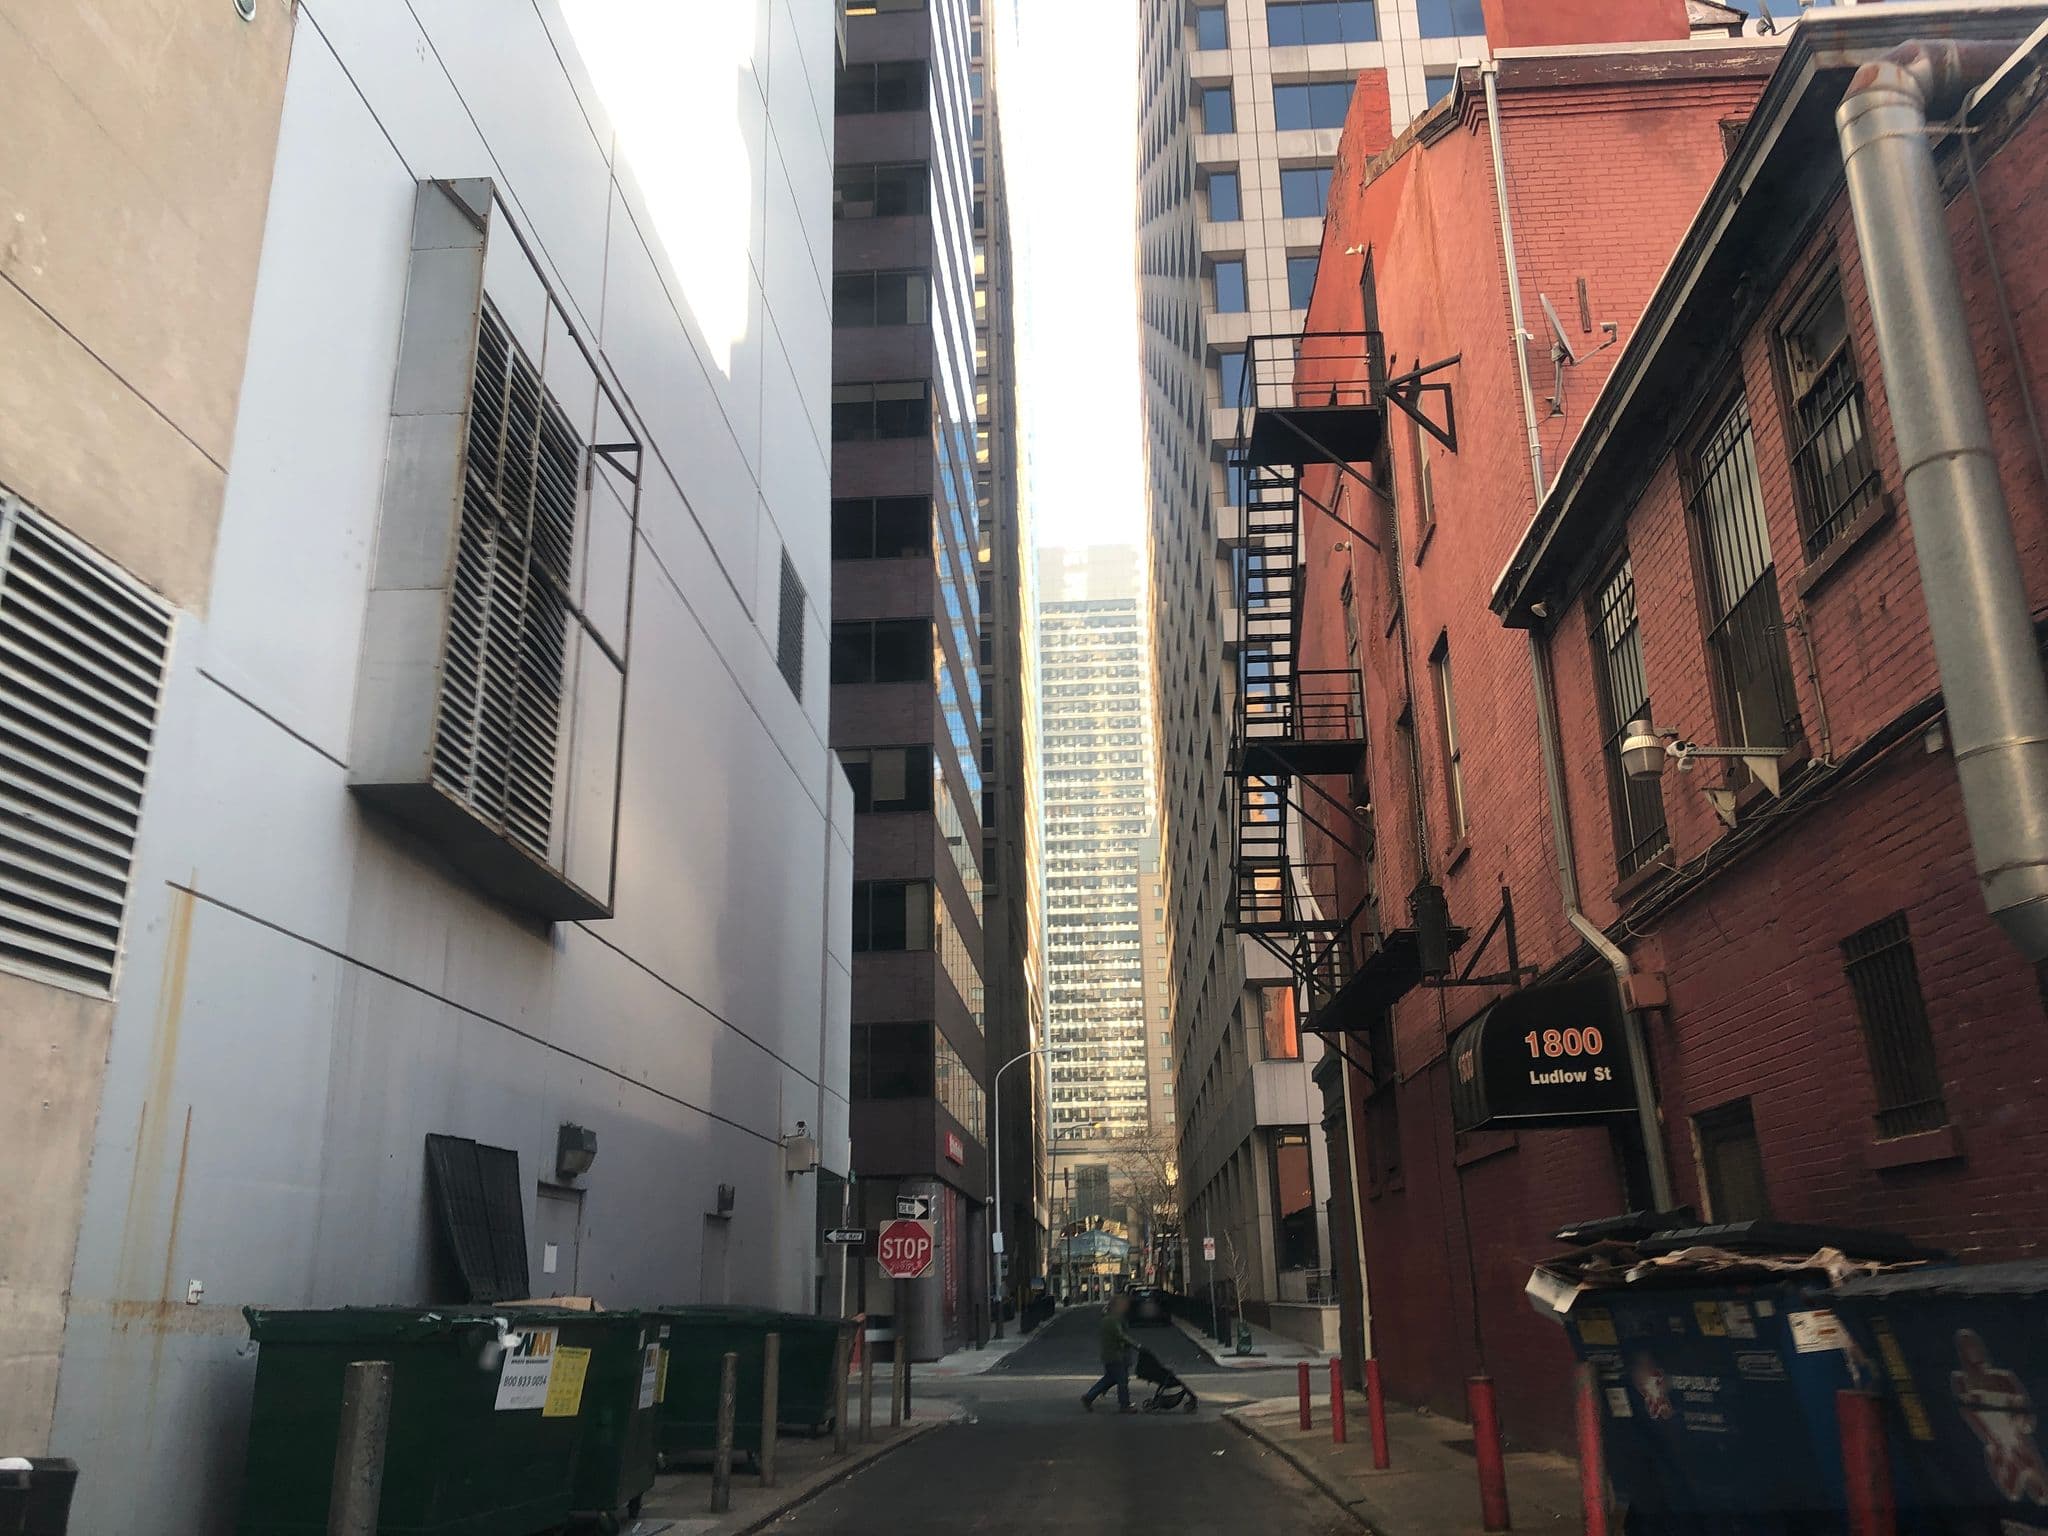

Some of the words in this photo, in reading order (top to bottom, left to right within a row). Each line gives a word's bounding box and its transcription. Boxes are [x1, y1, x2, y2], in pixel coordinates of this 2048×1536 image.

[1525, 1026, 1602, 1057] 1800
[1529, 1069, 1587, 1085] Ludlow
[1593, 1066, 1613, 1082] St
[882, 1238, 929, 1260] STOP
